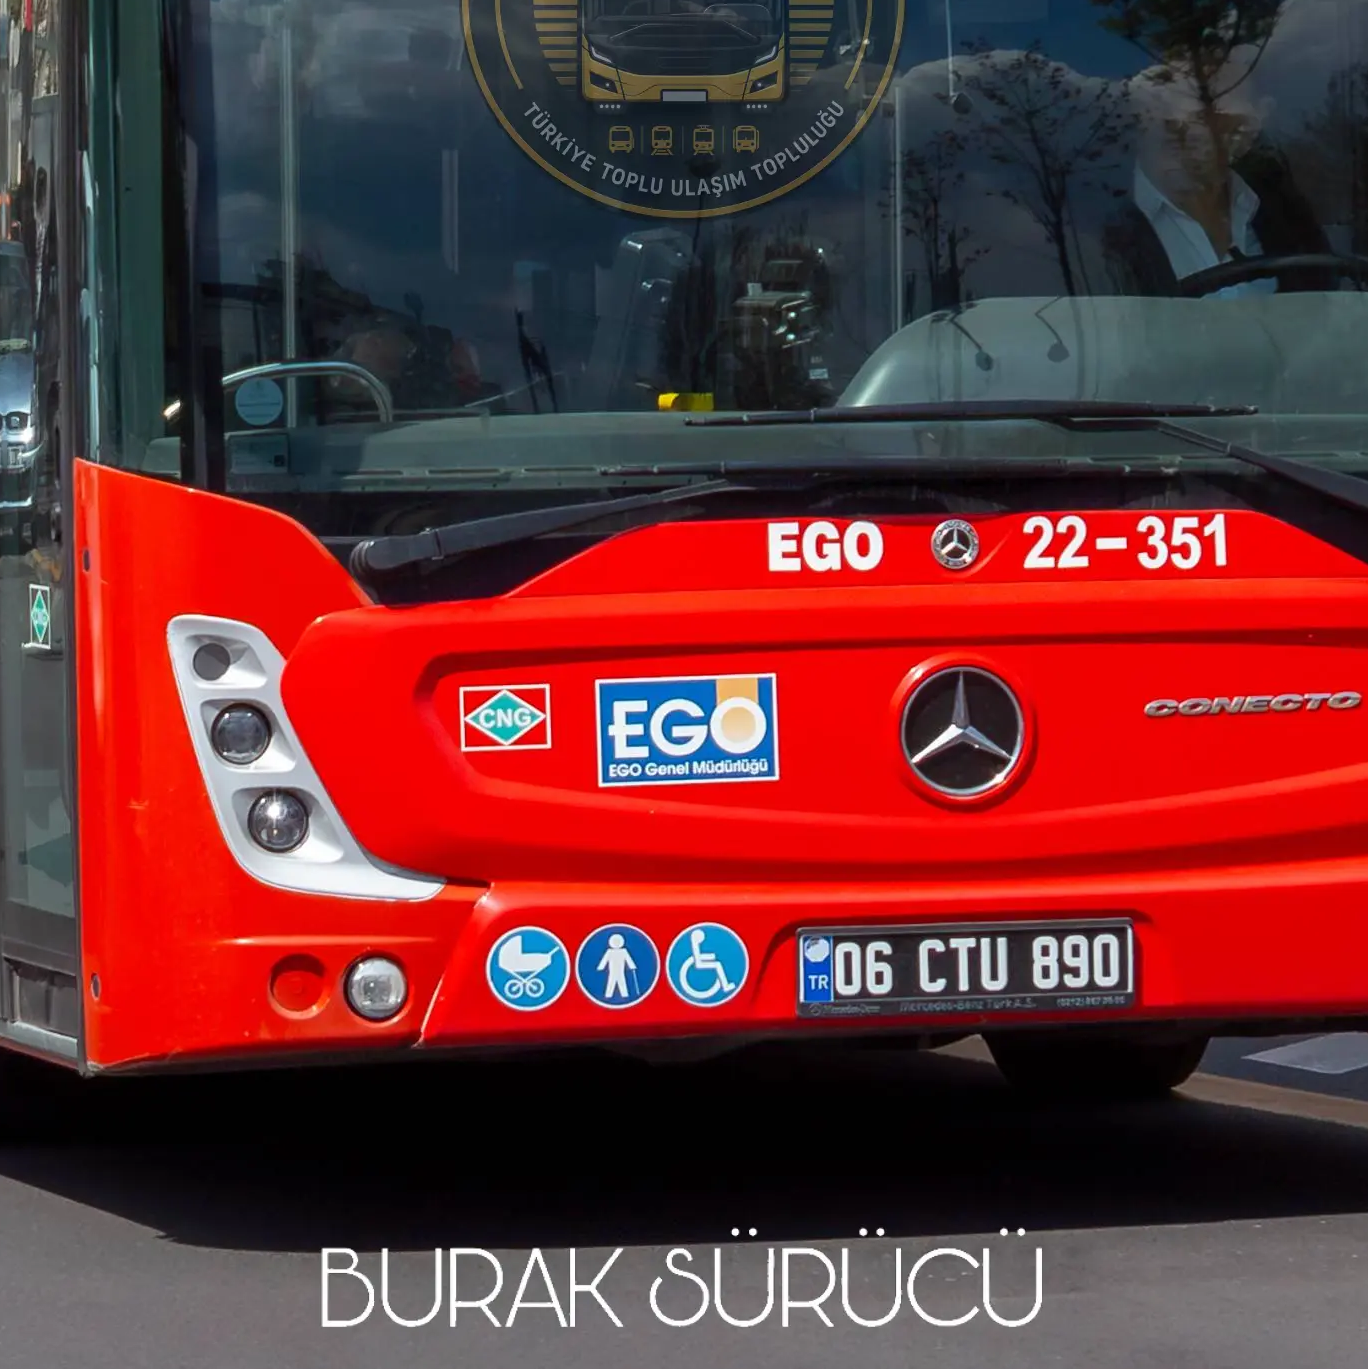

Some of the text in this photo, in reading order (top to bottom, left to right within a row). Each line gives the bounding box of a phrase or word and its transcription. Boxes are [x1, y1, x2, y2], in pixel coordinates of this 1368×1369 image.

[766, 521, 884, 572] EGO
[478, 707, 532, 729] CNG
[1143, 691, 1363, 717] CONECTO
[608, 696, 767, 759] EGO
[608, 758, 769, 778] EGO Genel Müdürlüğü
[808, 933, 1121, 996] TR 06 CTU 890
